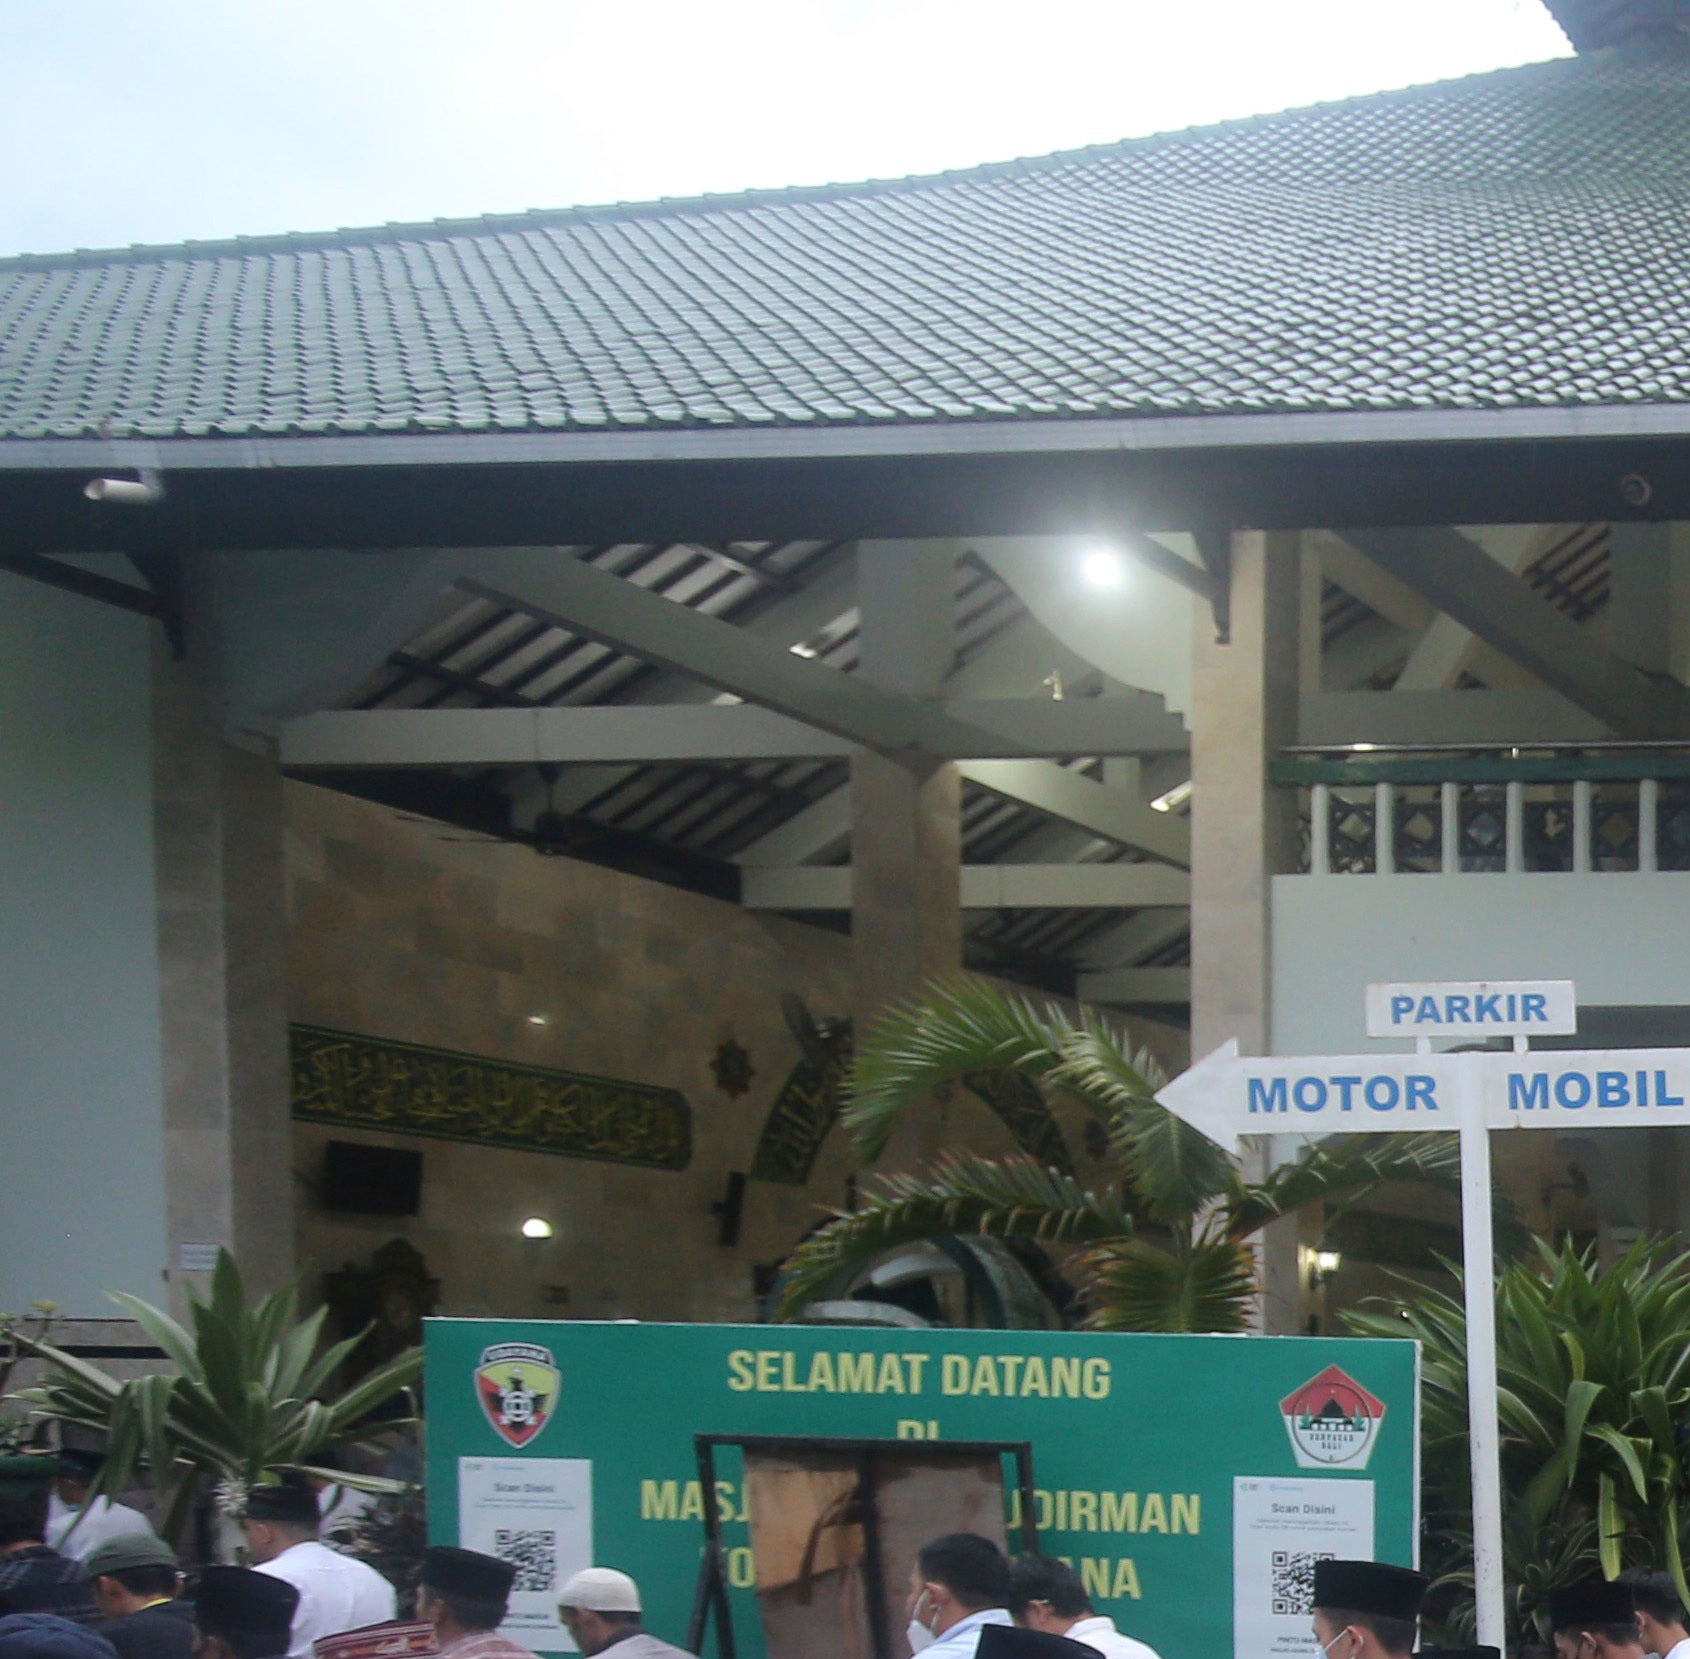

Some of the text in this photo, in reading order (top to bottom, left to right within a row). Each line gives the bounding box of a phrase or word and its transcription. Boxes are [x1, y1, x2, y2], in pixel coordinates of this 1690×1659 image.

[1391, 993, 1548, 1025] PARKIR
[1247, 1074, 1439, 1113] MOTOR
[1508, 1069, 1685, 1110] MOBIL
[728, 1350, 1110, 1400] SELAMAT DATANG
[641, 1479, 752, 1522] MASJ
[1271, 1503, 1336, 1515] Scan Disini
